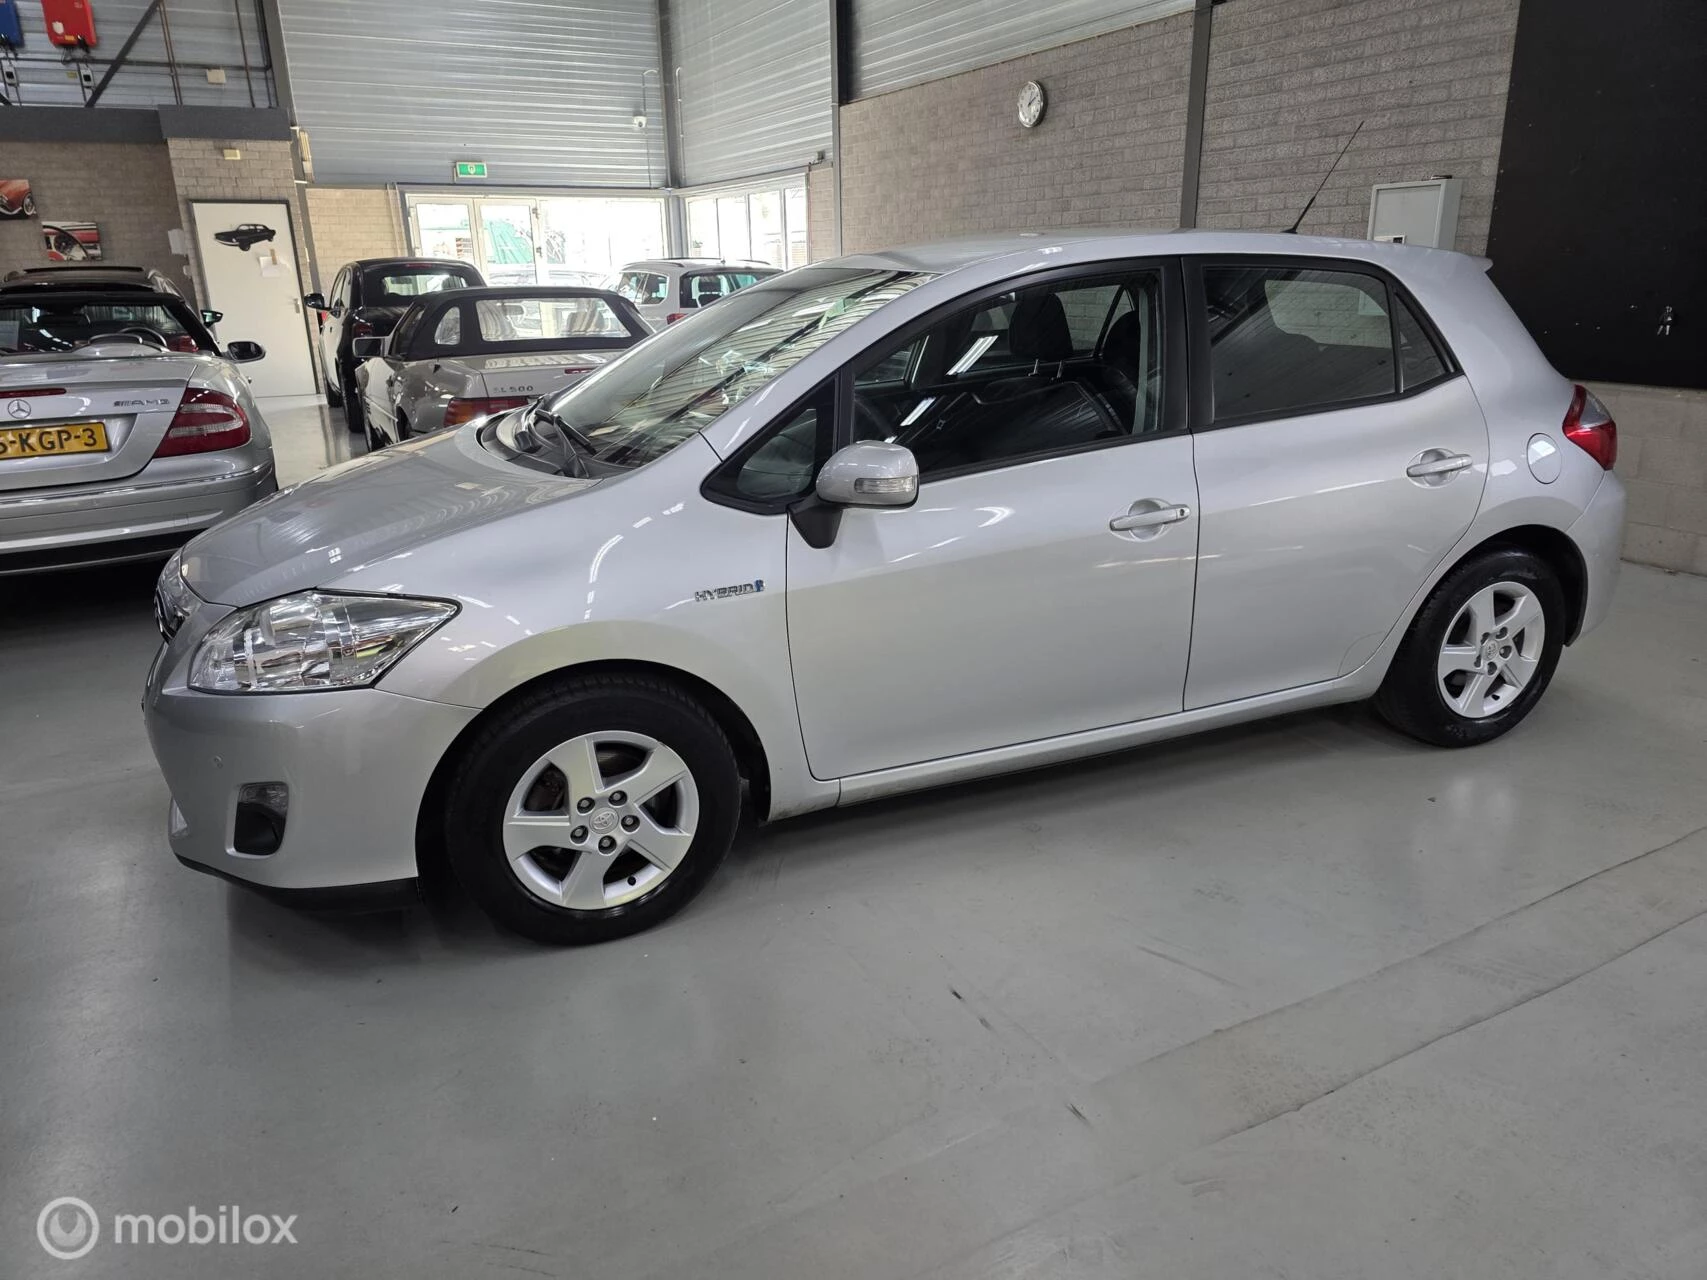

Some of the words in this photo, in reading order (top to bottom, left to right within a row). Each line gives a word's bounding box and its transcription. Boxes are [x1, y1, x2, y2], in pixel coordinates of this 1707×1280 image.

[510, 385, 534, 393] 500
[130, 398, 170, 407] AMG
[694, 583, 754, 602] HYBRID
